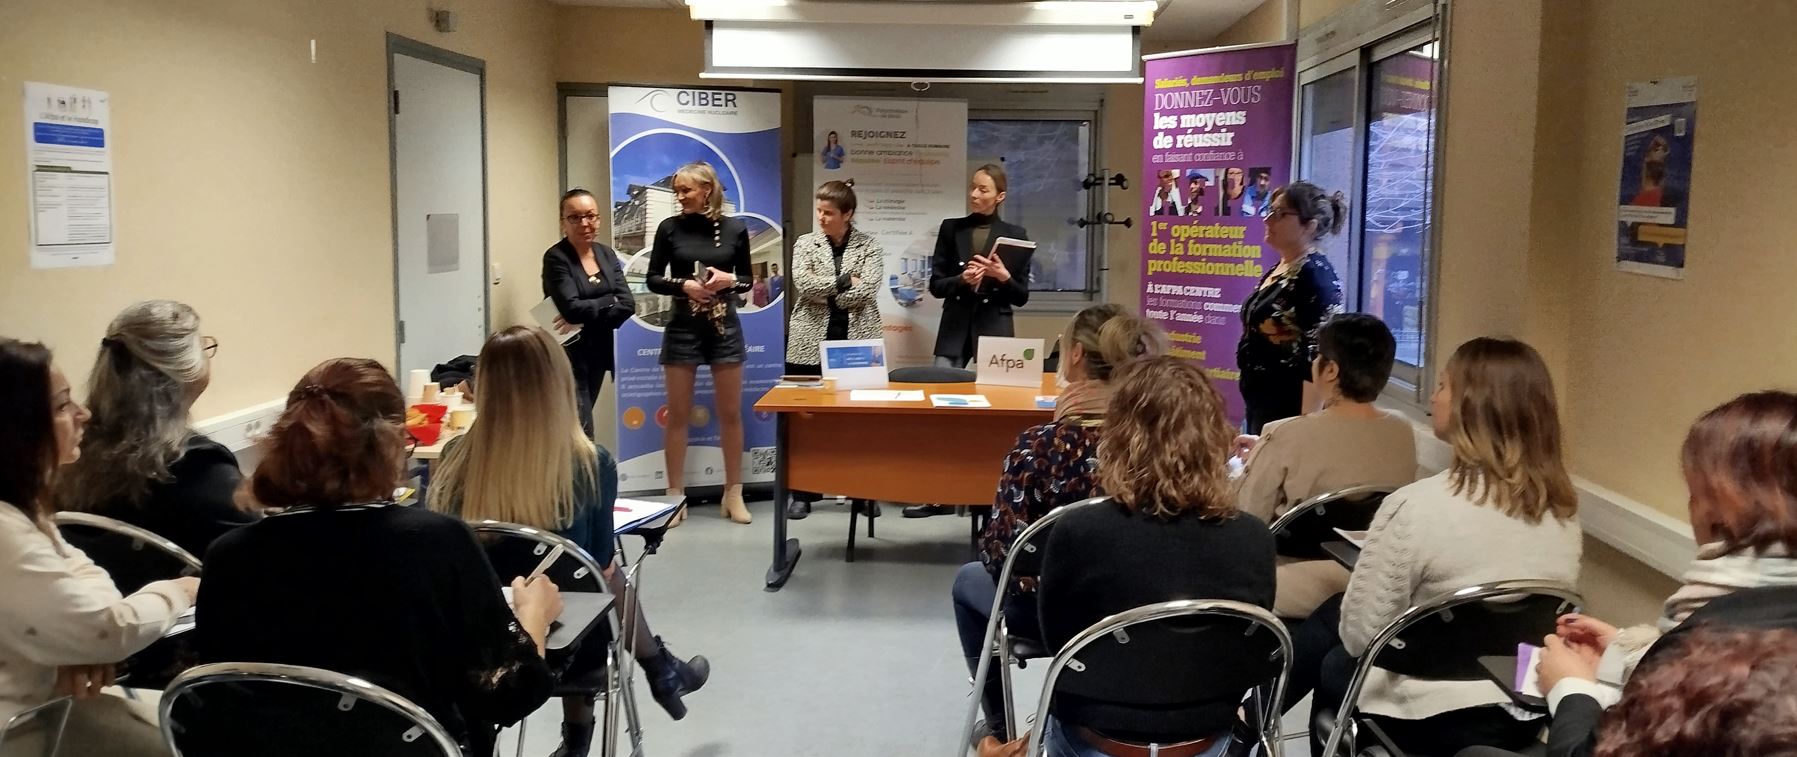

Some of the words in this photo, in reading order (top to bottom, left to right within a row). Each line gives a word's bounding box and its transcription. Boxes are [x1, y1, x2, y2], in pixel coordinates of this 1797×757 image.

[677, 90, 737, 108] CIBER
[1154, 85, 1261, 111] DONNEZ-VOUS
[1153, 112, 1178, 130] les
[1180, 110, 1246, 131] moyens
[850, 130, 907, 140] REJOIGNEZ
[1153, 132, 1174, 150] de
[1176, 129, 1235, 148] réussir
[1152, 155, 1163, 163] en
[1165, 151, 1193, 162] faisant
[1194, 150, 1235, 162] confiance
[1171, 219, 1247, 239] opérateur
[1148, 238, 1167, 255] de
[1169, 239, 1183, 255] la
[1187, 240, 1262, 258] formation
[1147, 257, 1263, 278] professionnelle
[1184, 285, 1222, 299] CENTRE
[1146, 308, 1169, 320] toute
[1159, 297, 1203, 311] formations
[988, 353, 1025, 373] Afpa
